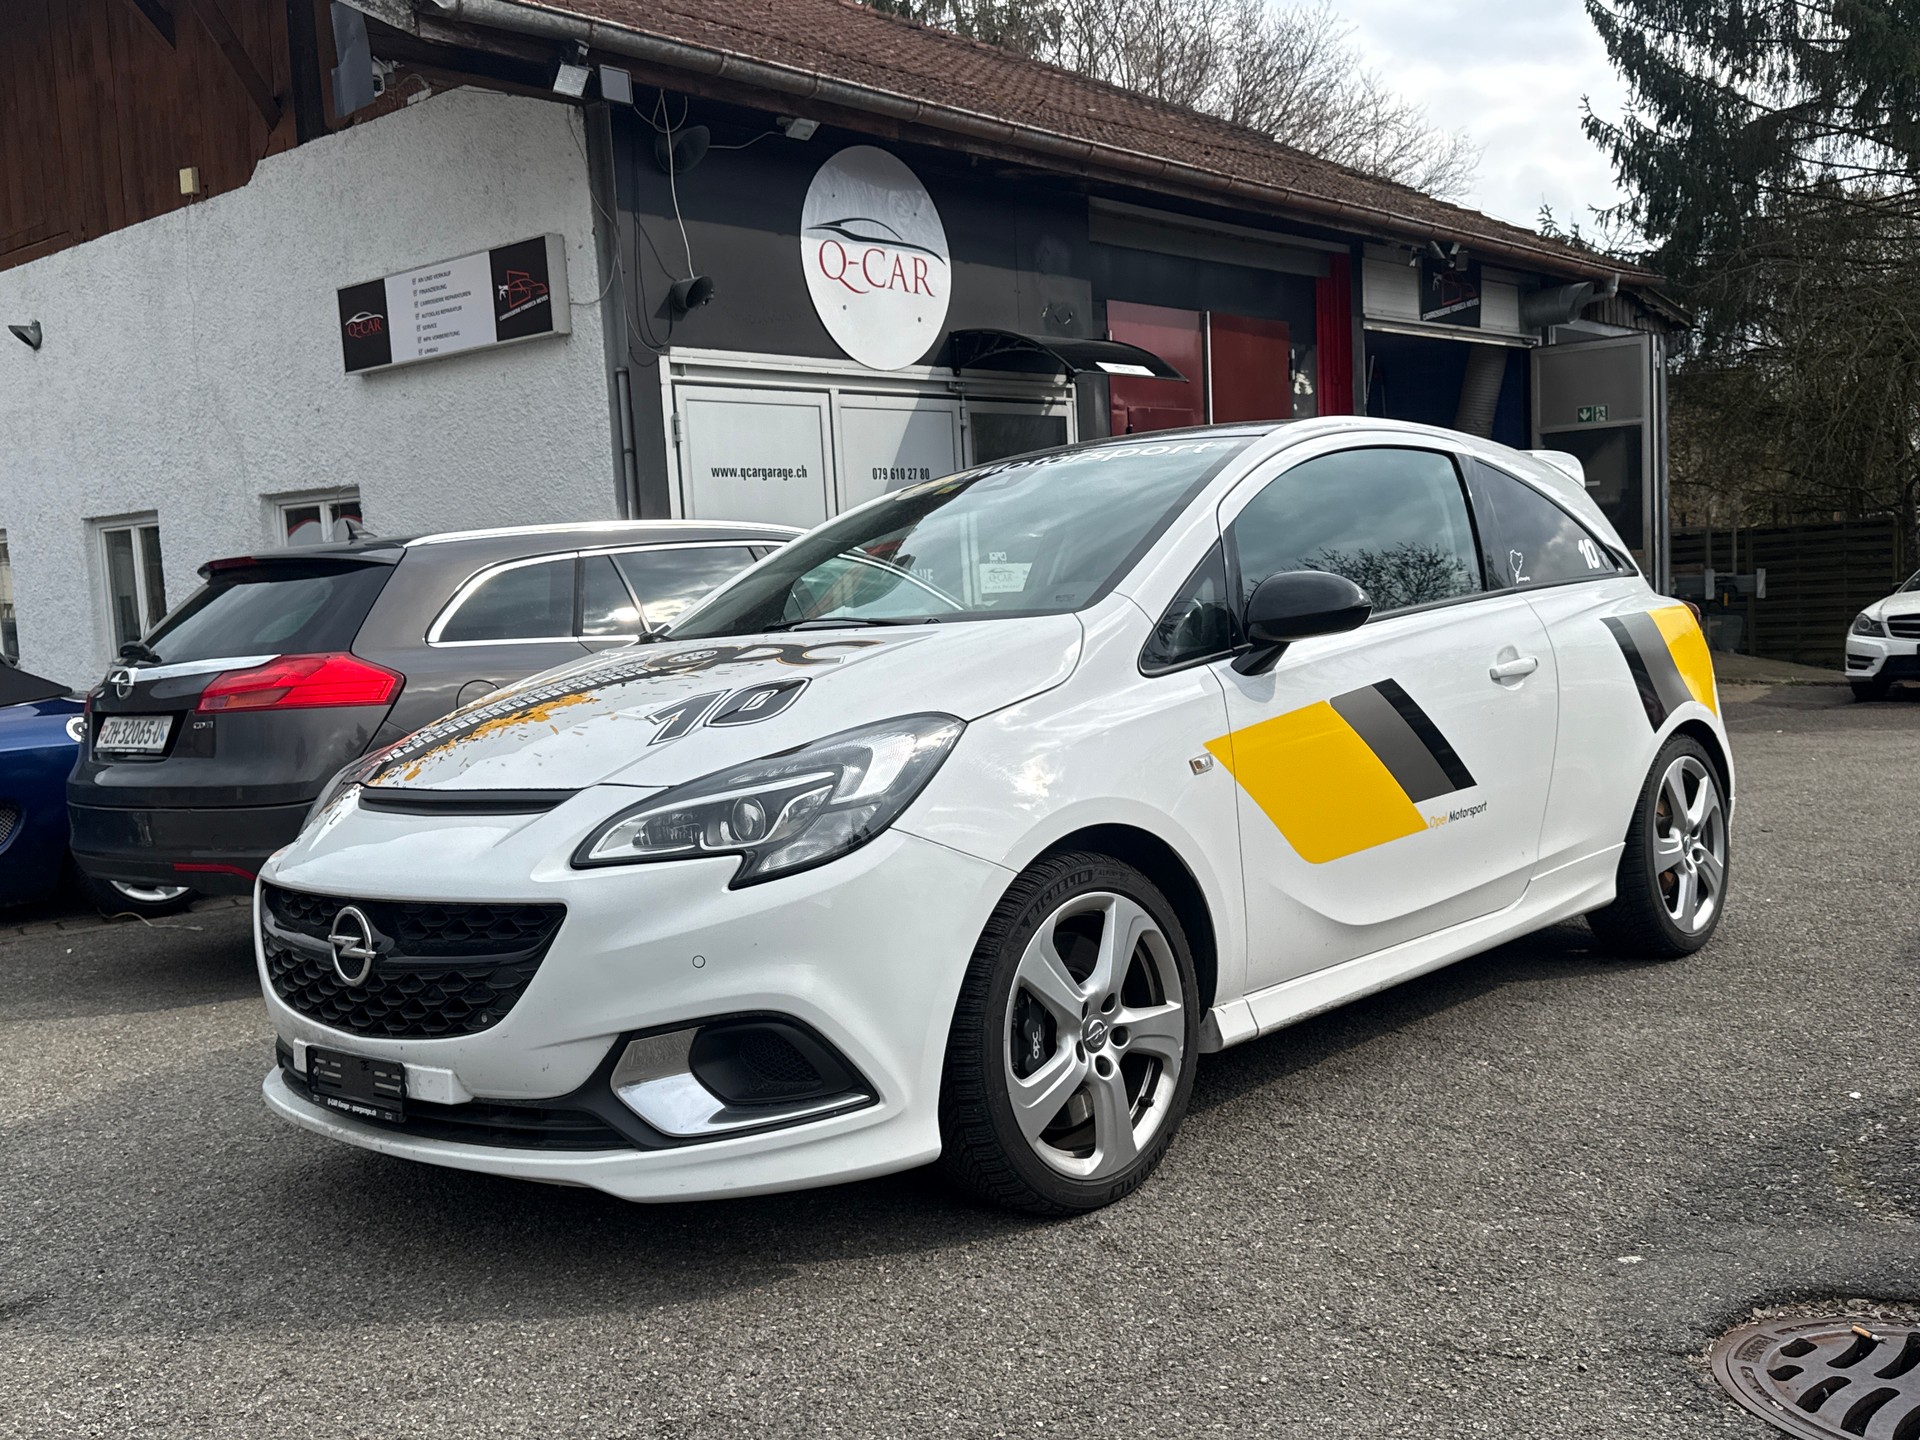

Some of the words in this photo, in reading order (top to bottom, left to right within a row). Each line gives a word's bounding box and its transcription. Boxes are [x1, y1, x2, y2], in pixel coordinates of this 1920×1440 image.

[819, 239, 936, 297] Q-CAR
[419, 284, 447, 294] FINANZIERUNG
[348, 318, 383, 339] Q-CAR
[422, 322, 437, 330] SERVICE
[711, 465, 808, 481] www.qcargarage.ch
[872, 467, 888, 480] 079
[890, 467, 906, 480] 610
[907, 468, 918, 480] 27
[919, 467, 930, 480] 80
[965, 442, 1216, 480] Motorsport
[1578, 538, 1600, 570] 10
[644, 676, 813, 747] 10
[1429, 811, 1447, 829] Opel
[1448, 800, 1487, 823] Motorsport
[1025, 869, 1090, 923] MICHELIN
